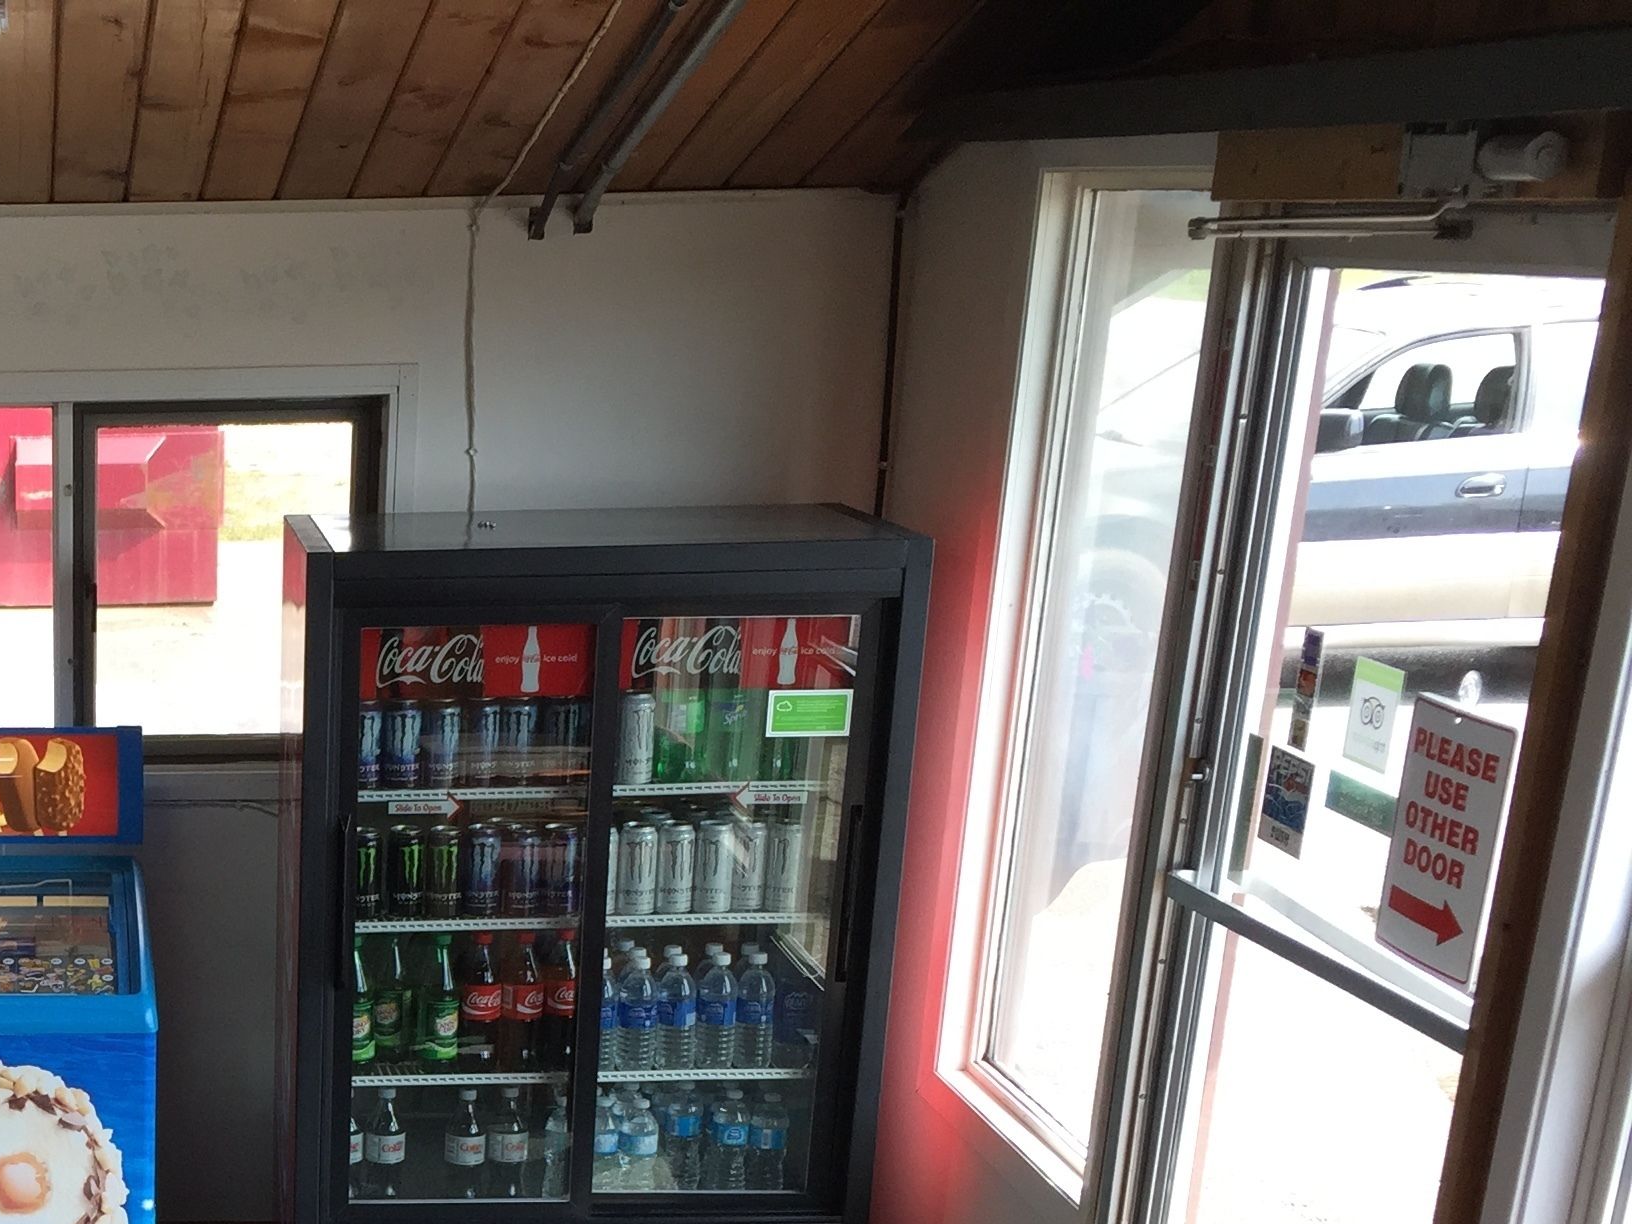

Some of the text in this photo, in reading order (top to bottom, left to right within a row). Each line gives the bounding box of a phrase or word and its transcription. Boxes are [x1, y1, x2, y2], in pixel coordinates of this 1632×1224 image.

[376, 634, 485, 688] Coca-Cola
[495, 656, 520, 665] enjoy
[543, 654, 556, 662] ice
[558, 653, 577, 662] cold
[631, 625, 741, 678] Coca-Cola
[752, 648, 778, 657] enjoy
[801, 647, 814, 655] ice
[1414, 727, 1500, 783] PLEASE
[753, 793, 801, 803] Slide To Open
[1424, 770, 1469, 812] USE
[394, 804, 442, 814] Slide To Open
[1405, 801, 1479, 855] OTHER
[1403, 838, 1465, 889] DOOR
